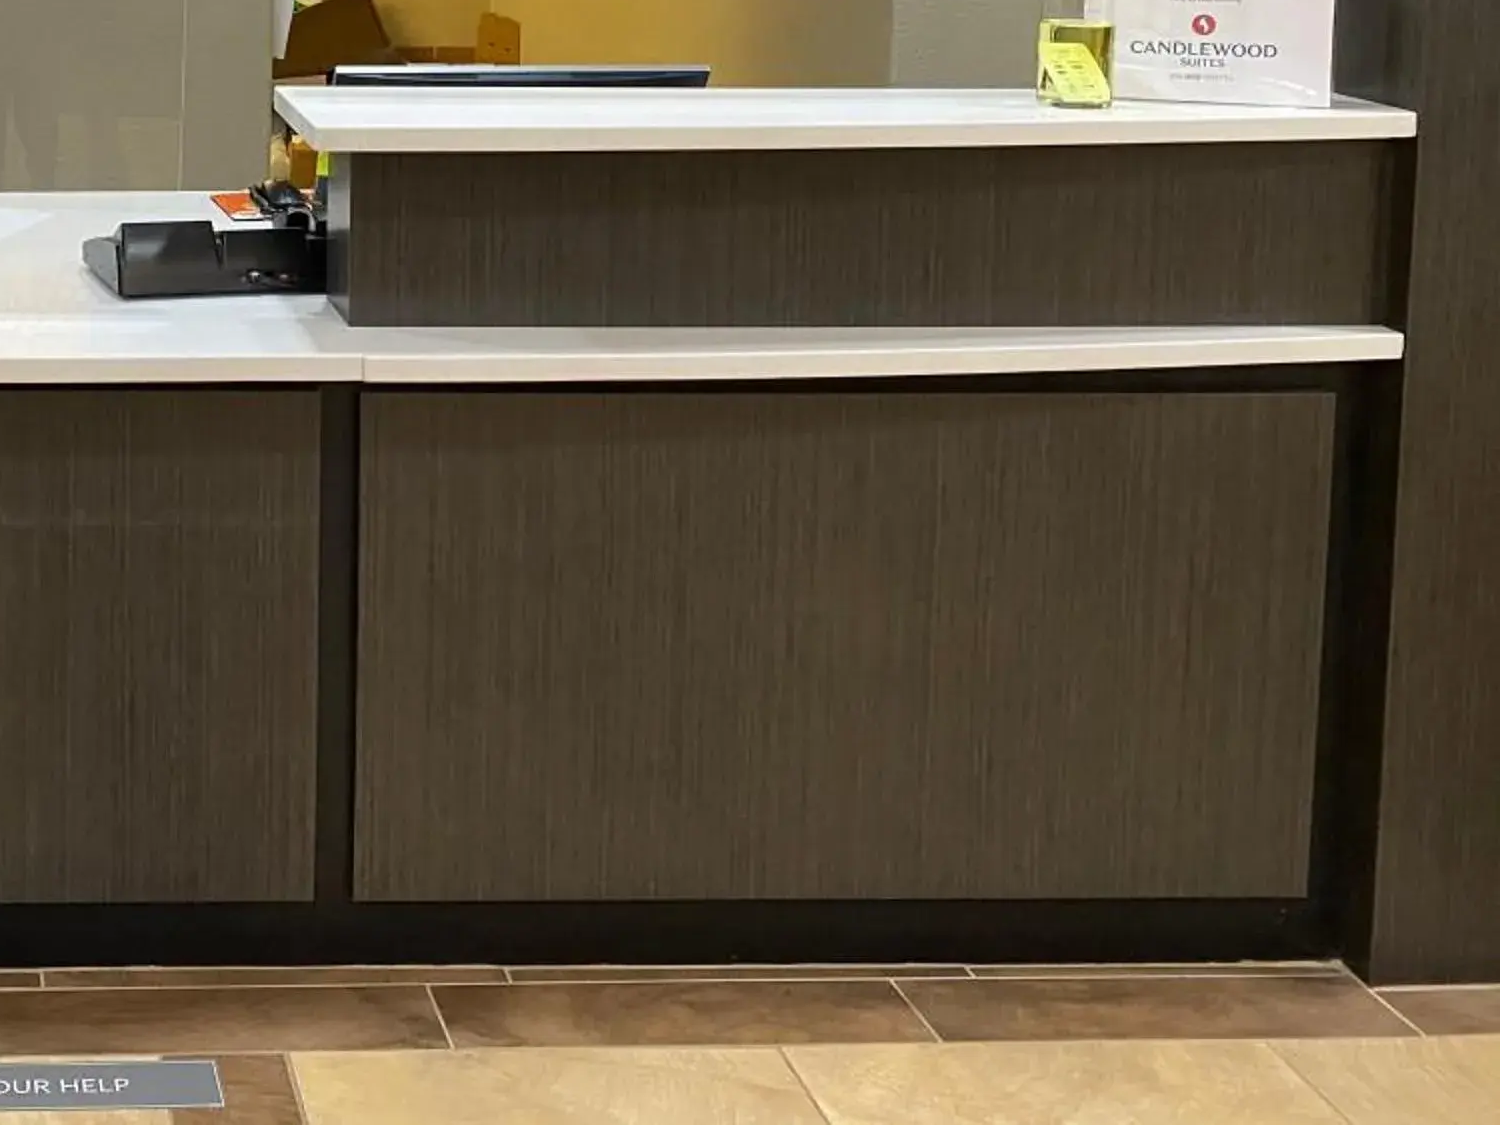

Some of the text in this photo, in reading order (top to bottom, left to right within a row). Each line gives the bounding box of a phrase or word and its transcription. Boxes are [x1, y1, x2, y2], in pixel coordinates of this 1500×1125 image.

[1130, 40, 1278, 58] CANDLEWOOD
[1179, 57, 1226, 68] SUITES
[60, 1077, 129, 1094] HELP
